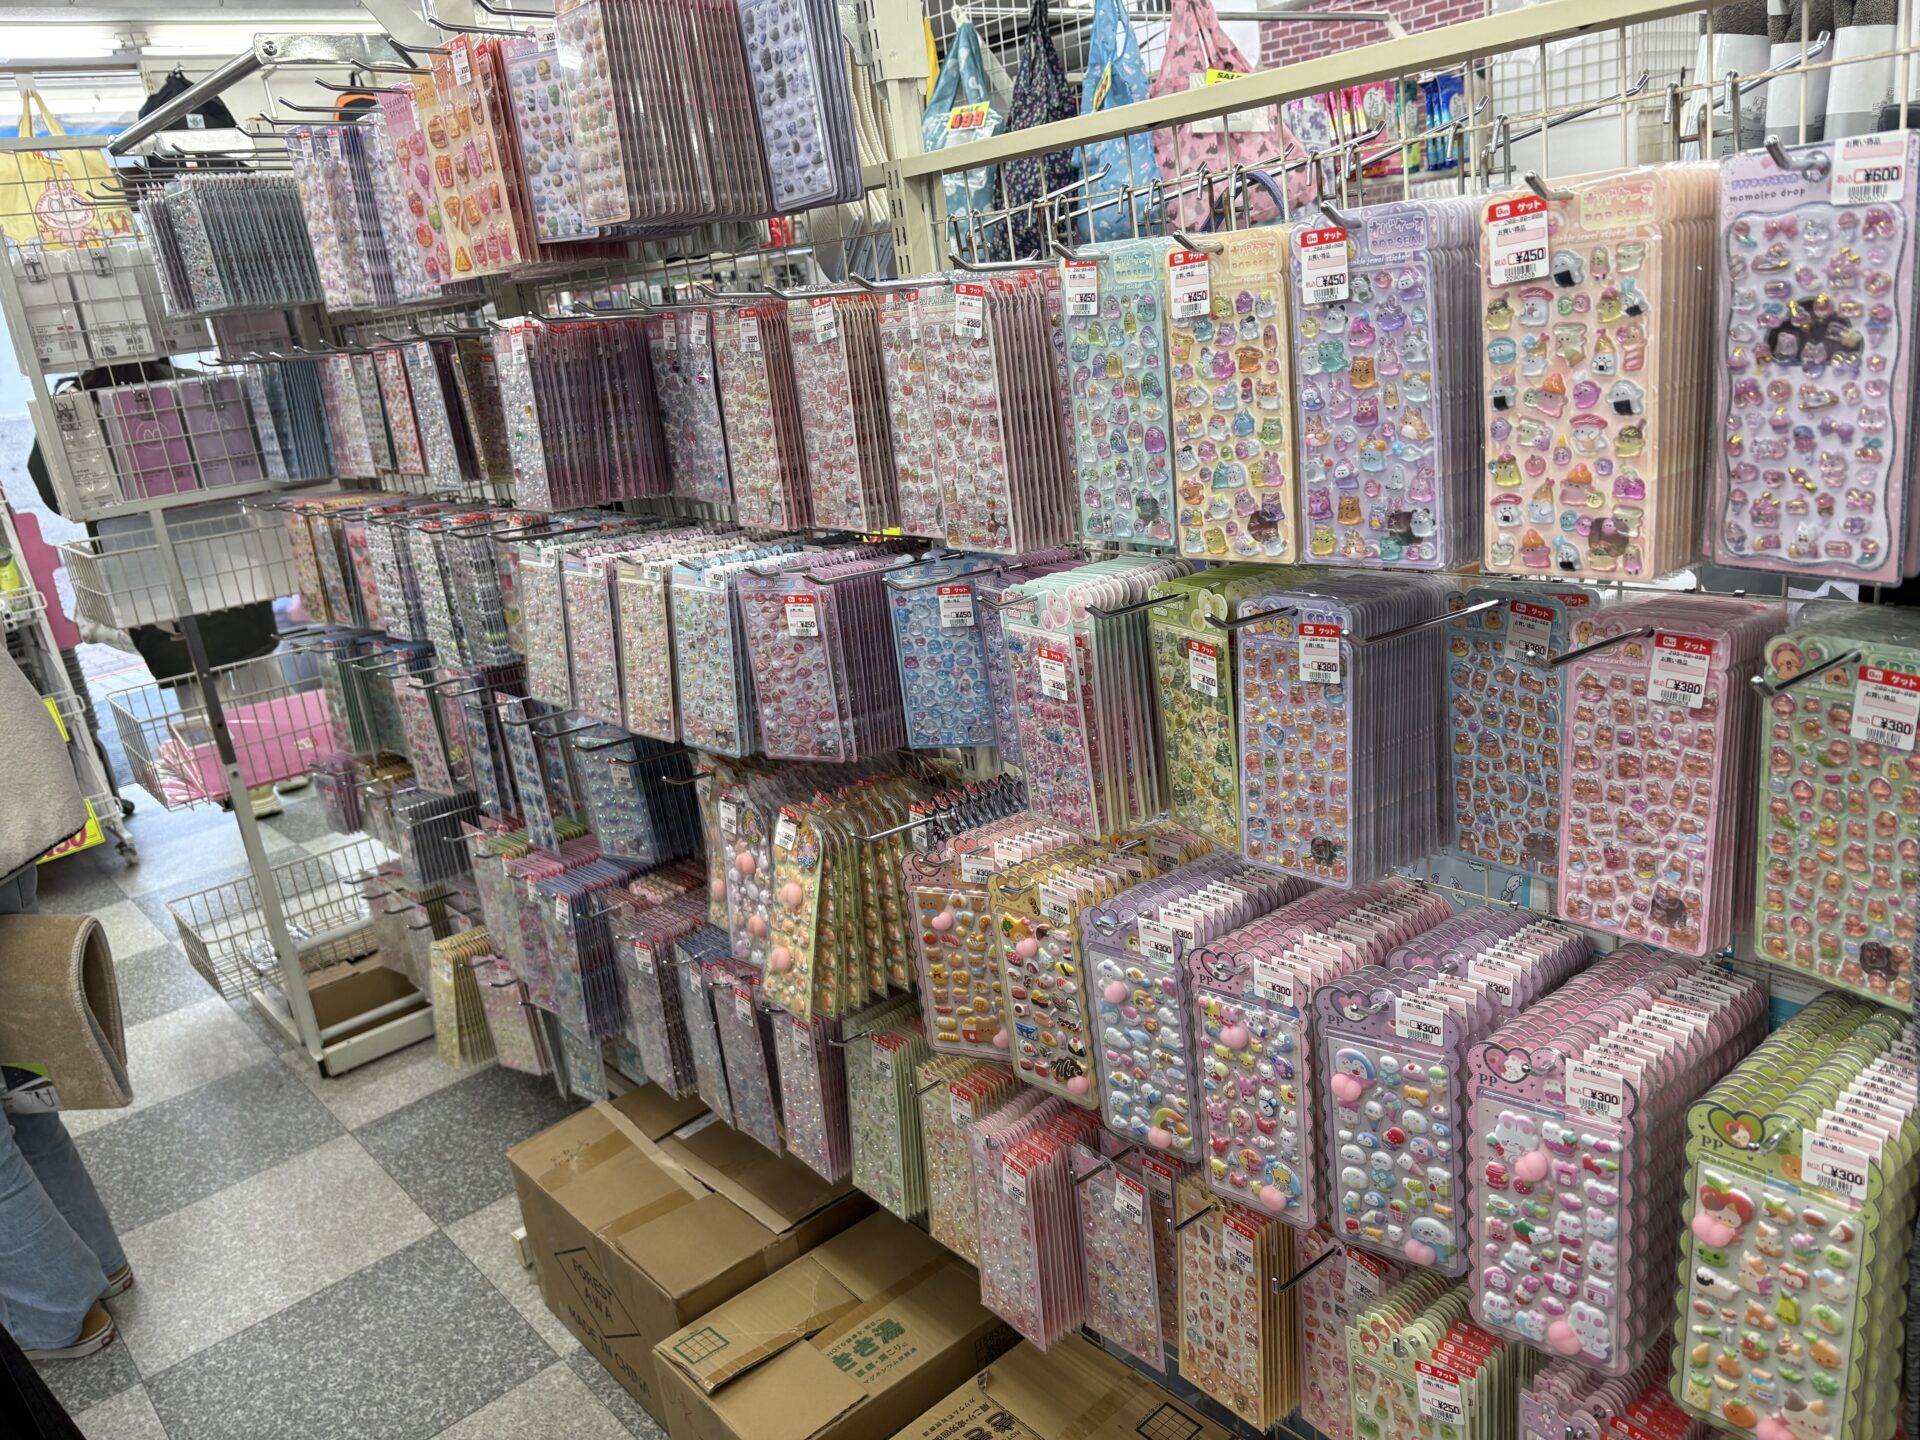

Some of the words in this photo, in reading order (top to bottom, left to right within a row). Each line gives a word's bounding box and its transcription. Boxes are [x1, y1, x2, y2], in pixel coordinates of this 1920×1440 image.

[1864, 167, 1900, 182] ¥600
[1729, 190, 1777, 203] momoiro
[1781, 187, 1806, 199] drop
[1517, 200, 1542, 212] ゲット
[1323, 231, 1343, 241] ゲット
[1497, 225, 1527, 237] お買い得品
[1372, 238, 1394, 250] POP
[1188, 252, 1206, 262] ゲット
[1365, 256, 1385, 267] jewel
[1386, 253, 1411, 264] sticker
[1516, 248, 1545, 264] ¥450
[1323, 273, 1346, 287] ¥450
[1079, 293, 1096, 303] ¥450
[1187, 292, 1207, 303] ¥450
[956, 610, 972, 620] ¥450
[1531, 608, 1549, 617] ゲット
[801, 621, 816, 629] ¥450
[1525, 641, 1545, 655] ¥380
[1683, 641, 1707, 651] ゲット
[1317, 662, 1337, 673] ¥380
[1052, 682, 1066, 692] ¥300
[1202, 676, 1216, 687] ¥300
[1674, 680, 1701, 695] ¥380
[1891, 676, 1918, 688] ゲット
[1881, 720, 1912, 735] ¥380
[1163, 856, 1178, 866] ¥300
[911, 873, 923, 883] PP
[1053, 905, 1068, 916] ¥300
[1088, 929, 1100, 940] PP
[1176, 928, 1193, 940] ¥300
[1155, 943, 1172, 954] ¥300
[1199, 974, 1213, 986] PP
[1272, 984, 1291, 997] ¥300
[1487, 982, 1510, 996] ¥300
[1327, 1014, 1344, 1026] PP
[1416, 1022, 1440, 1035] ¥300
[1478, 1073, 1498, 1087] PP
[1590, 1091, 1618, 1105] ¥300
[1701, 1135, 1724, 1150] PP
[1812, 1140, 1845, 1154] お買い得品
[1830, 1168, 1863, 1185] ¥300
[1012, 1186, 1025, 1198] ¥250
[1155, 1189, 1171, 1200] ¥250
[1127, 1203, 1141, 1216] ¥250
[1238, 1225, 1252, 1237] ゲット
[1236, 1249, 1251, 1264] ¥250
[1362, 1260, 1377, 1272] ゲット
[1468, 1341, 1487, 1352] ゲット
[1460, 1351, 1478, 1362] ゲット
[614, 1353, 649, 1392] CHINA
[1454, 1362, 1472, 1373] ゲット
[1437, 1371, 1455, 1381] ゲット
[1438, 1400, 1460, 1414] ¥250
